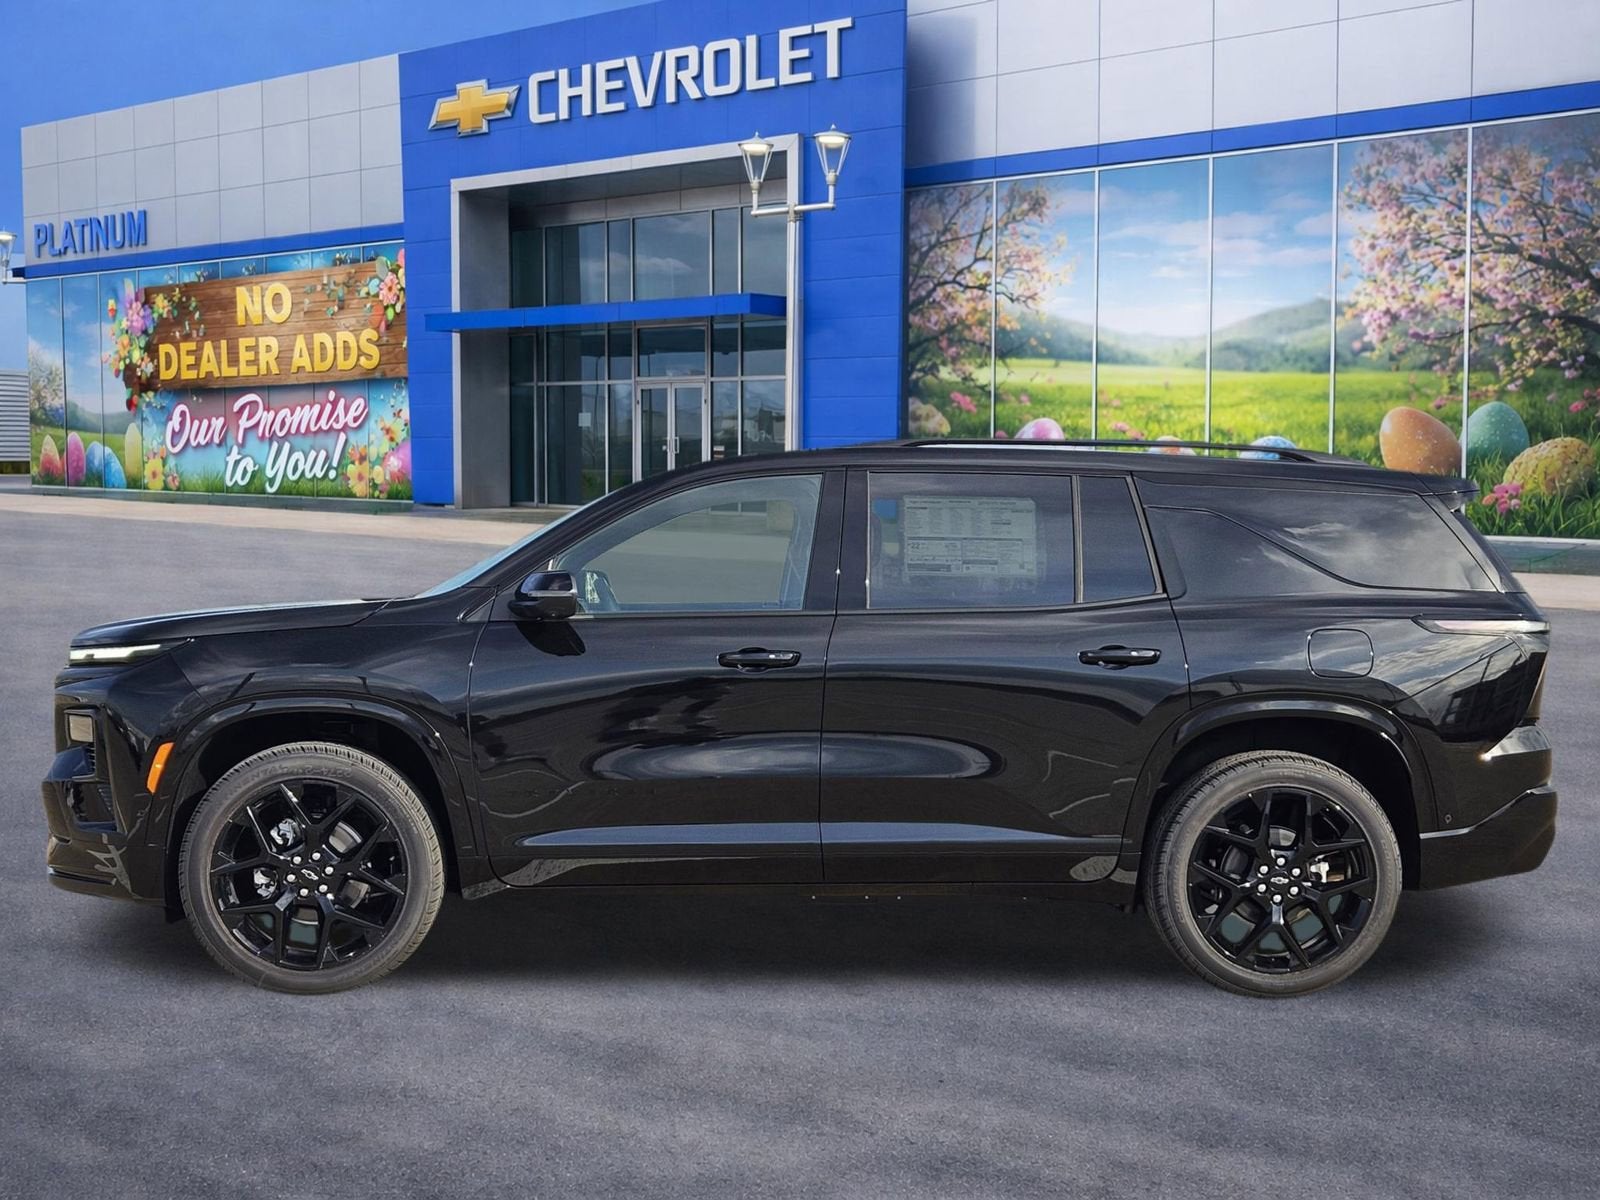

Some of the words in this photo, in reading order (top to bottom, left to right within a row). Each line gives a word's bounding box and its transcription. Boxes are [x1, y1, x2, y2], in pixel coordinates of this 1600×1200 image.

[528, 17, 853, 125] CHEVROLET
[33, 209, 147, 258] PLATINUM
[235, 283, 292, 325] NO
[158, 336, 279, 380] DEALER
[290, 328, 382, 372] ADDS
[165, 404, 228, 454] Our
[233, 391, 368, 441] Promise
[225, 447, 257, 487] to
[265, 433, 345, 492] You!
